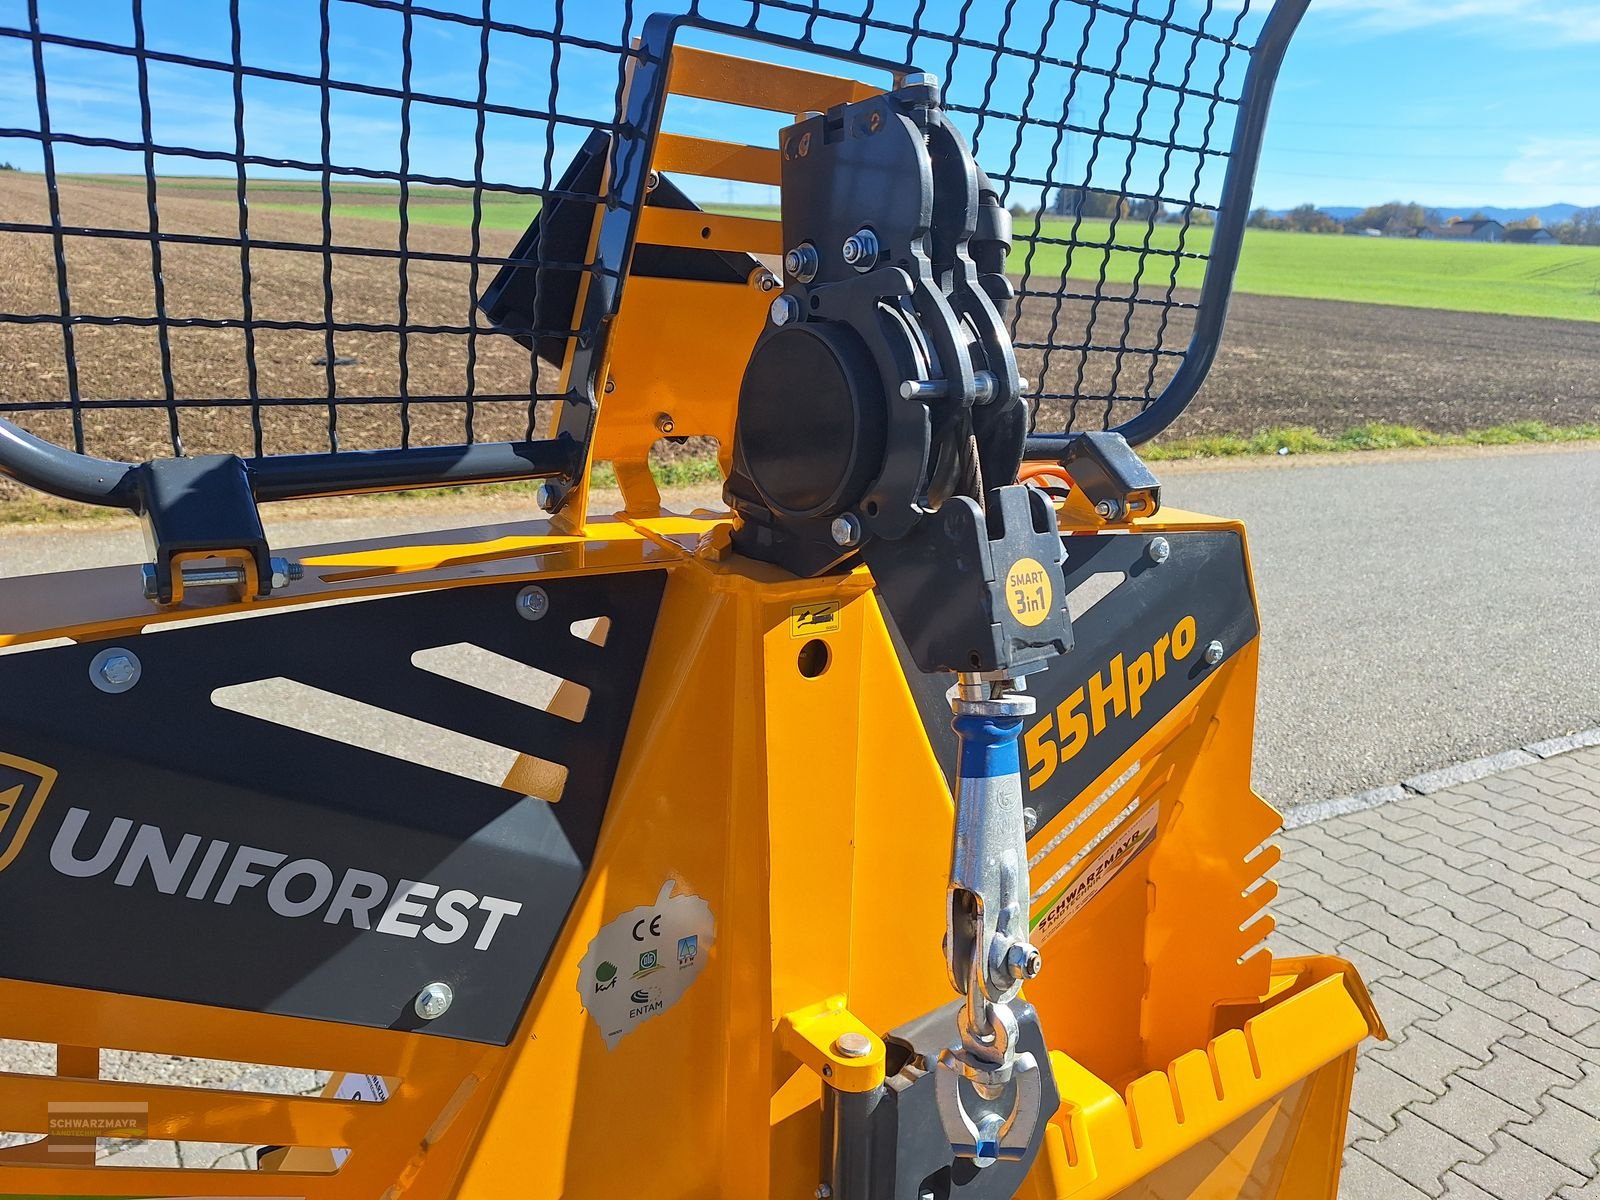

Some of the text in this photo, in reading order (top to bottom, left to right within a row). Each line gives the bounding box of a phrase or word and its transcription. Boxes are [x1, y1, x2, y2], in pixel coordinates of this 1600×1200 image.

[1010, 571, 1044, 587] SMART
[1015, 586, 1046, 615] 3in1
[1024, 615, 1197, 791] 55Hpro
[49, 807, 524, 951] UNIFOREST
[1038, 830, 1140, 930] SCHWARZMAYR
[632, 914, 662, 942] CE
[629, 1000, 663, 1019] ENTAM
